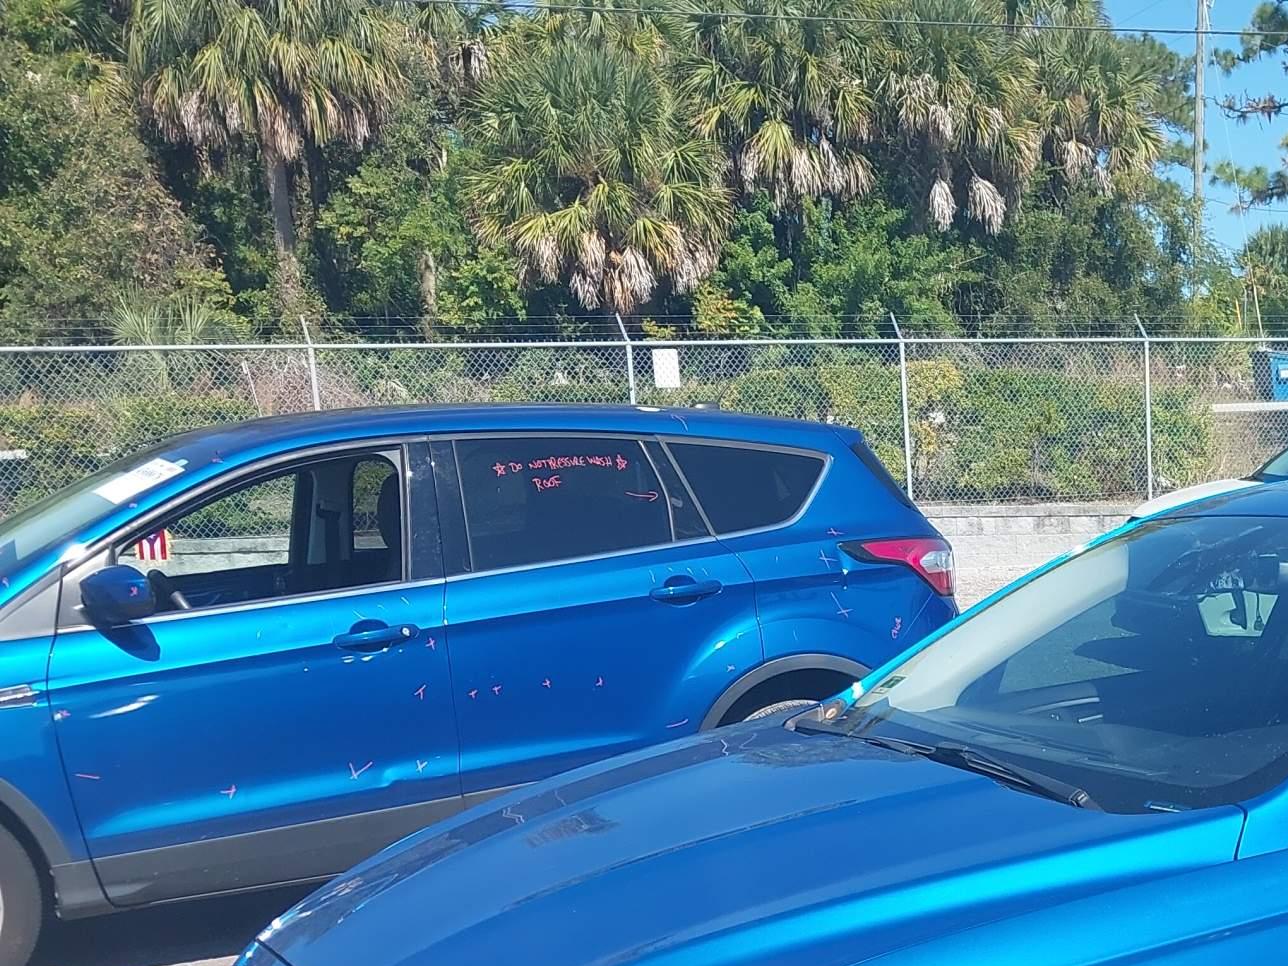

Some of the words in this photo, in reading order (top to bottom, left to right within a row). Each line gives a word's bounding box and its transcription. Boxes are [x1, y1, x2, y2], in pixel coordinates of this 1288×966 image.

[528, 459, 549, 469] NOT
[586, 455, 613, 467] WASH
[532, 475, 562, 492] ROOF
